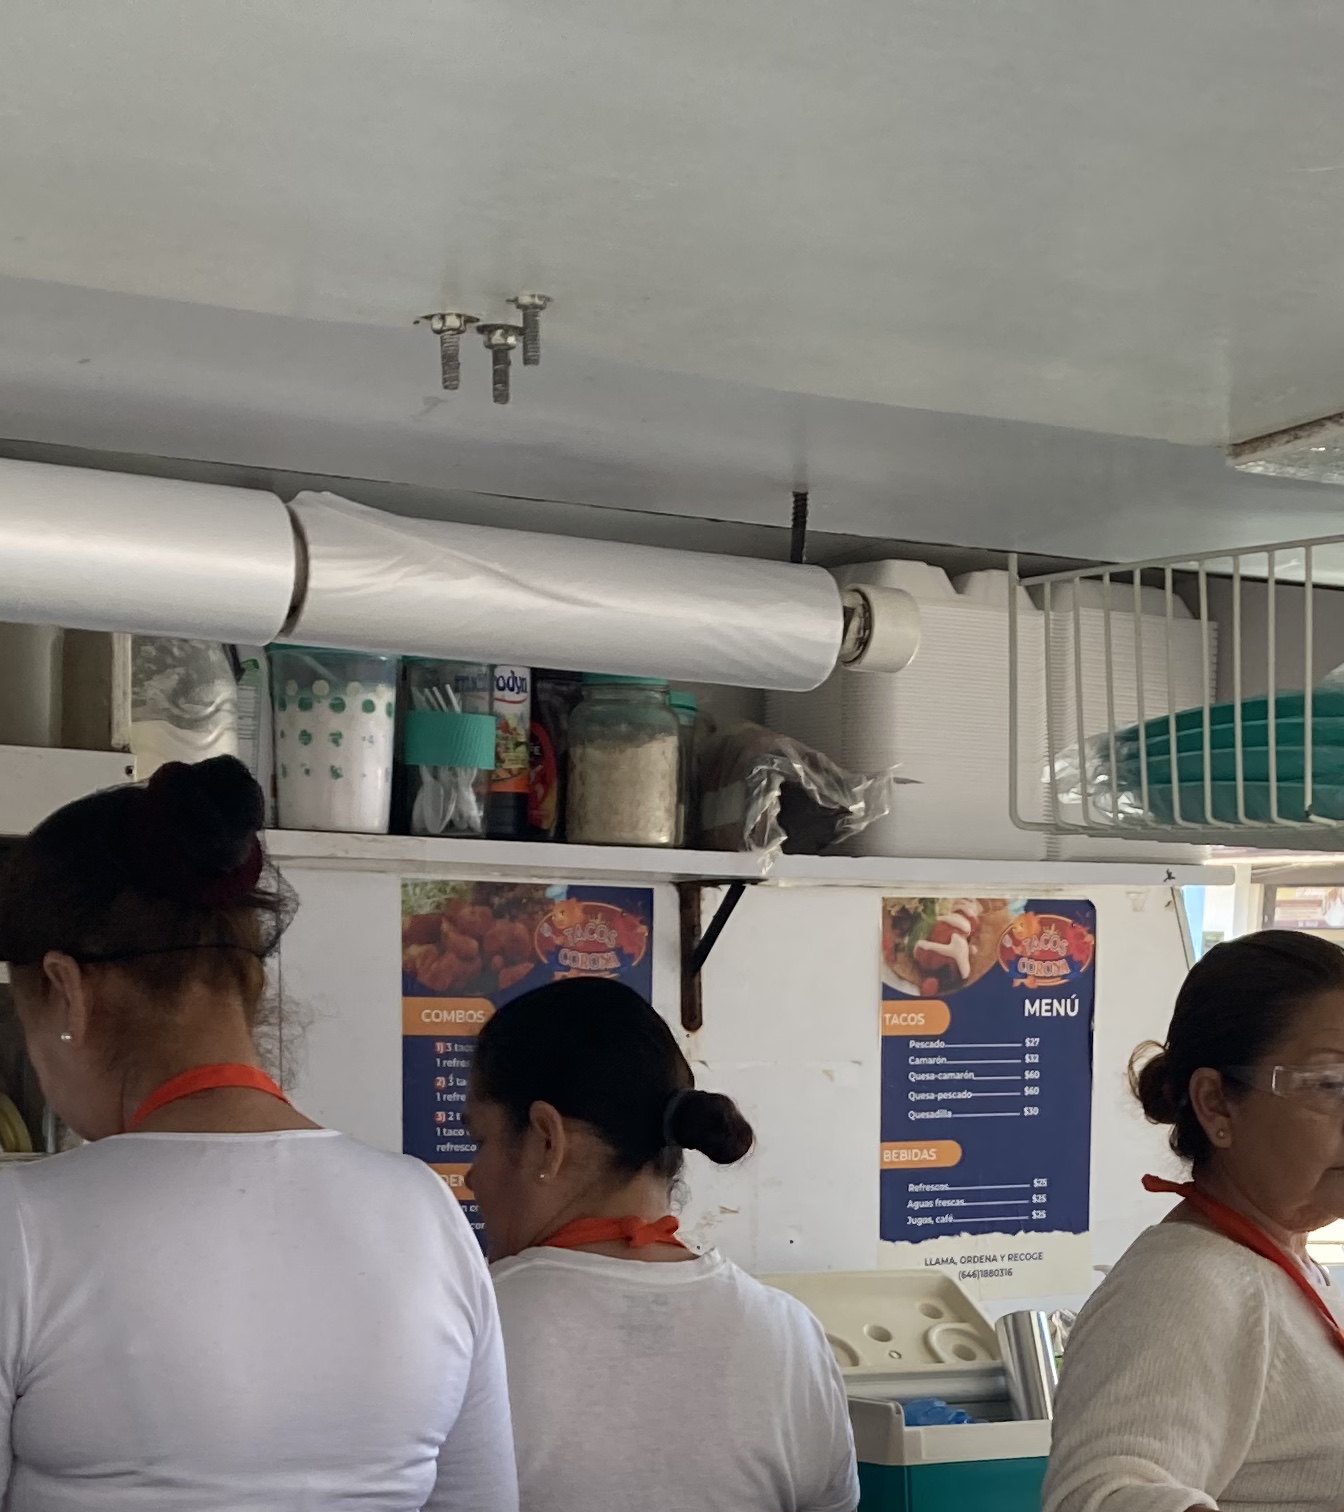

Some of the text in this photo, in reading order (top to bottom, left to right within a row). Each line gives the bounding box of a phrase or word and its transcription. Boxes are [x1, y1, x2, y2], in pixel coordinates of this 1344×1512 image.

[563, 923, 617, 948] TACOS
[1022, 931, 1069, 956] TACOS
[558, 950, 621, 971] CORONA
[1017, 957, 1071, 978] CORONA
[1024, 994, 1080, 1017] MENÚ
[421, 1009, 485, 1023] COMBOS
[884, 1012, 926, 1026] TACOS
[909, 1037, 1041, 1049] Pescado $27
[436, 1058, 441, 1067] 1
[908, 1053, 1040, 1065] Camarón $32
[908, 1069, 1041, 1082] Quesa-camarón $60
[436, 1092, 441, 1101] 1
[908, 1086, 1040, 1102] Quesa-pescado $60
[908, 1106, 1040, 1121] Quesadilla $30
[436, 1127, 464, 1136] 1 taco
[436, 1142, 477, 1152] refresco
[882, 1149, 937, 1162] BEBIDAS
[908, 1182, 949, 1193] Refrescos
[907, 1199, 934, 1210] Aguas
[935, 1197, 965, 1207] frescas
[907, 1215, 934, 1226] Jugos,
[924, 1251, 1044, 1267] LLAMA, ORDENA Y RECOGE
